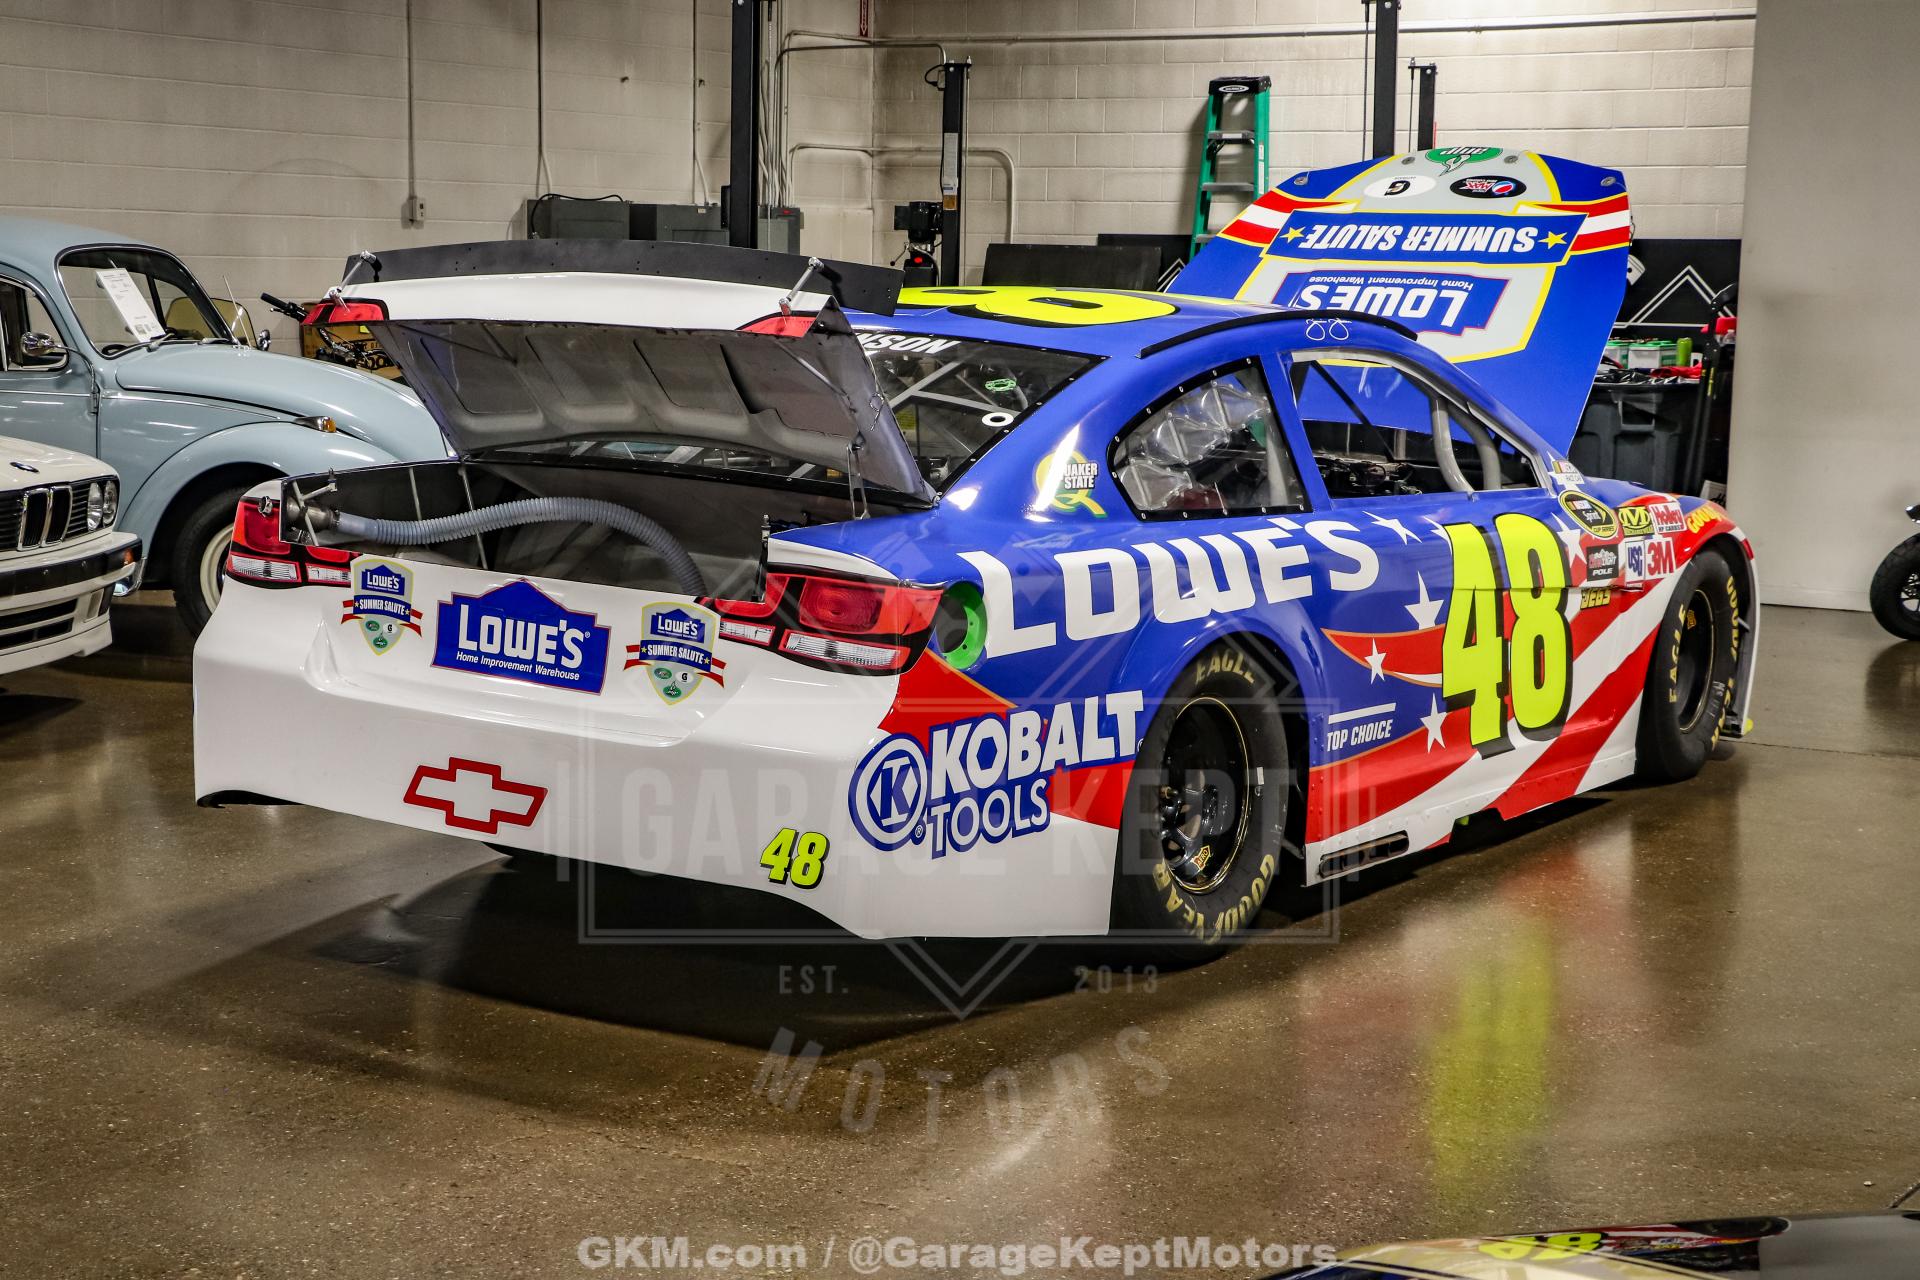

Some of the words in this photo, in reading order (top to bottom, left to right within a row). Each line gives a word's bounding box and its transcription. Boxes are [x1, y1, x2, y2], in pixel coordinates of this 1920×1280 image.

[1299, 224, 1403, 250] SALUTE
[1401, 226, 1538, 252] SUMMER
[1309, 275, 1364, 285] Warehouse
[1367, 276, 1439, 288] Improvement
[1441, 279, 1473, 290] Home
[1064, 476, 1095, 489] STATE
[1065, 463, 1098, 476] UAKER
[1647, 540, 1675, 577] 3M
[366, 571, 400, 590] LOWE'S
[1593, 568, 1613, 576] POLE
[956, 518, 1381, 658] LOWE'S
[359, 599, 383, 610] SUMMER
[384, 601, 406, 616] SALUTE
[458, 604, 584, 669] LOWE'S
[657, 615, 698, 636] LOWE'S
[1442, 512, 1572, 756] 48
[456, 651, 483, 663] Home
[480, 655, 533, 673] Improvement
[535, 664, 580, 681] Warehouse
[647, 644, 677, 657] SUMMER
[678, 647, 705, 664] SALUTE
[931, 690, 1145, 800] KOBALT
[1326, 727, 1349, 752] TOP
[1350, 719, 1394, 746] CHOICE
[926, 778, 1048, 853] TOOLS
[760, 827, 830, 890] 48
